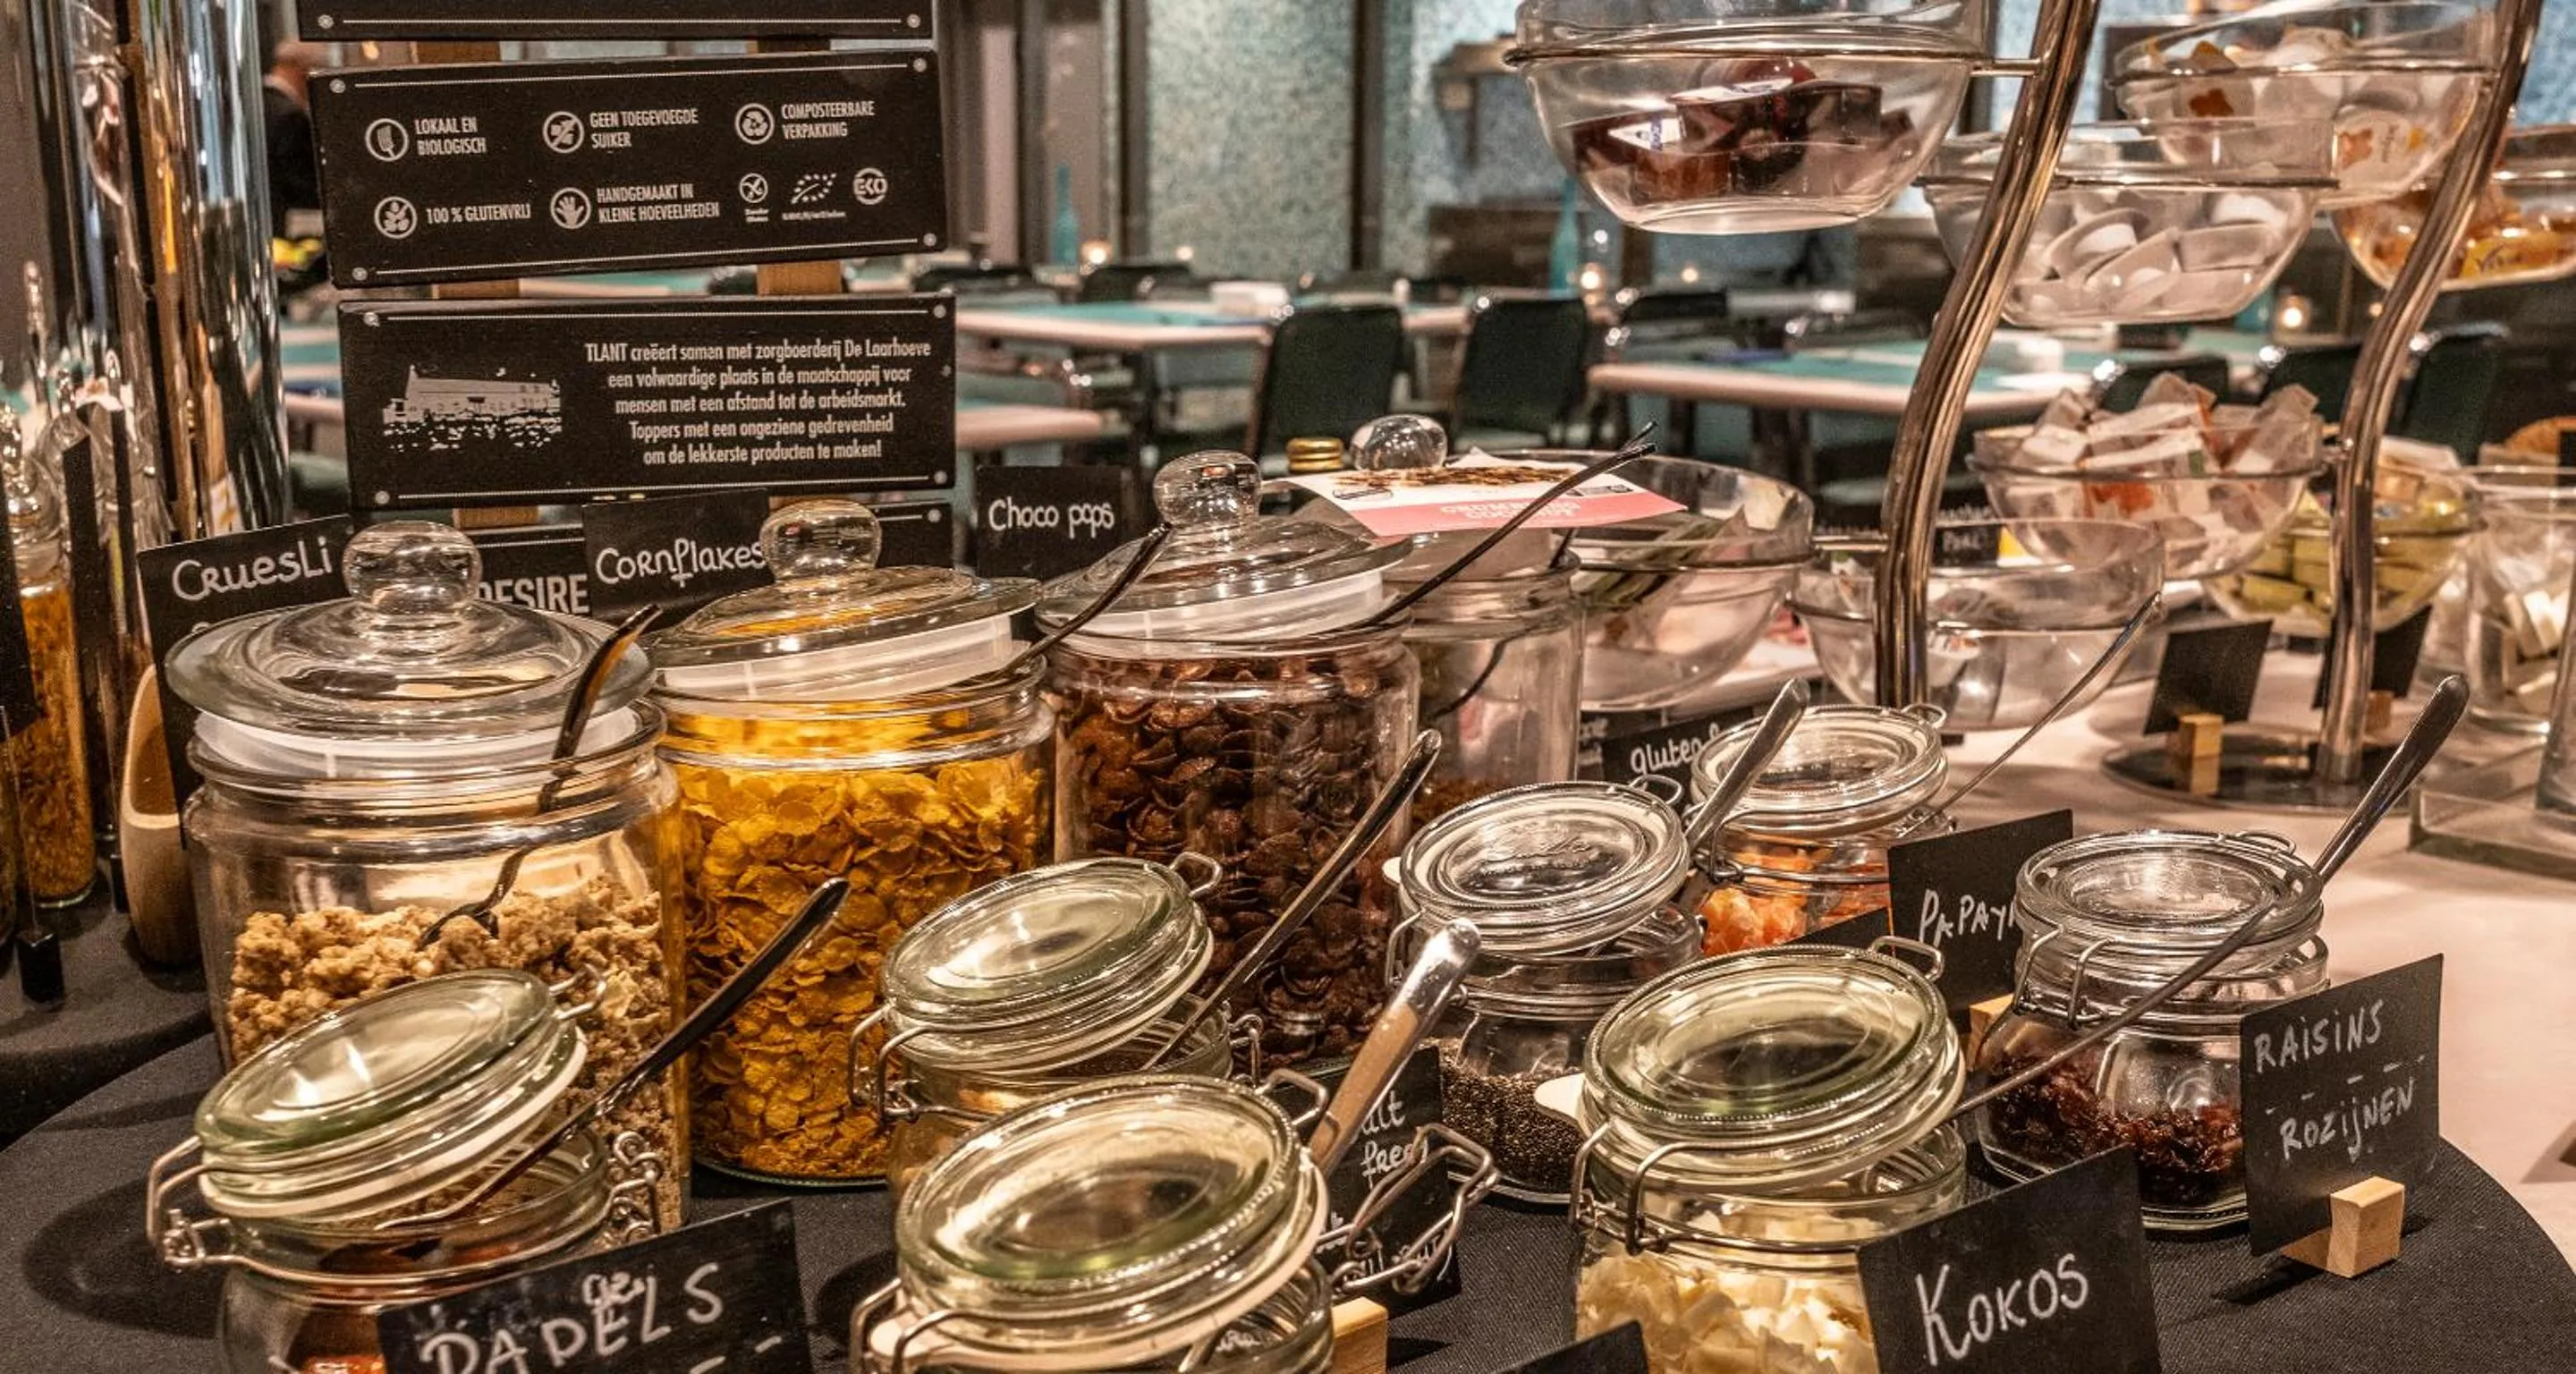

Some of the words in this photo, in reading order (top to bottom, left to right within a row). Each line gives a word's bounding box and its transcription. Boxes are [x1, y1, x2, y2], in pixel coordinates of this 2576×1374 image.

[589, 112, 619, 128] GEEN
[621, 108, 699, 126] TOEGEVOEGDE
[781, 101, 875, 119] COMPOSTEERBARE
[414, 118, 460, 134] LOKAAL
[462, 117, 478, 133] EN
[782, 122, 848, 140] VERPAKKING
[417, 138, 487, 156] BIOLOGISCH
[591, 131, 632, 148] SUIKER
[597, 184, 679, 203] HANDGEMAAKT
[681, 183, 694, 199] IN
[426, 208, 447, 224] 100
[451, 208, 462, 222] %
[464, 203, 531, 221] GLUTENVRIJ
[598, 207, 637, 223] KLEINE
[639, 202, 719, 221] HOEVEELHEDEN
[584, 343, 628, 362] TLANT
[631, 343, 677, 361] creëert
[680, 345, 723, 360] samen
[726, 344, 751, 360] met
[755, 338, 841, 362] zorgboerderij
[843, 339, 862, 358] De
[866, 336, 931, 357] Laarhoeve
[608, 374, 633, 387] een
[636, 367, 716, 390] volwaardige
[719, 365, 759, 390] plaats
[761, 367, 774, 384] in
[777, 364, 794, 384] de
[797, 363, 880, 386] maatschappij
[883, 368, 911, 382] voor
[615, 400, 667, 413] mensen
[670, 396, 696, 412] met
[699, 398, 724, 411] een
[726, 390, 775, 411] afstand
[778, 394, 795, 409] tot
[799, 389, 815, 409] de
[818, 387, 906, 408] arbeidsmarkt.
[629, 420, 681, 443] Toppers
[683, 421, 709, 437] met
[712, 423, 736, 437] een
[740, 417, 805, 440] ongeziene
[809, 411, 894, 438] gedrevenheid
[643, 451, 665, 465] om
[668, 444, 685, 463] de
[688, 443, 749, 463] lekkerste
[751, 440, 814, 465] producten
[818, 443, 830, 459] te
[834, 438, 882, 459] maken!
[988, 496, 1059, 531] Choco
[1068, 502, 1115, 539] pops
[595, 538, 767, 588] Cornflakes
